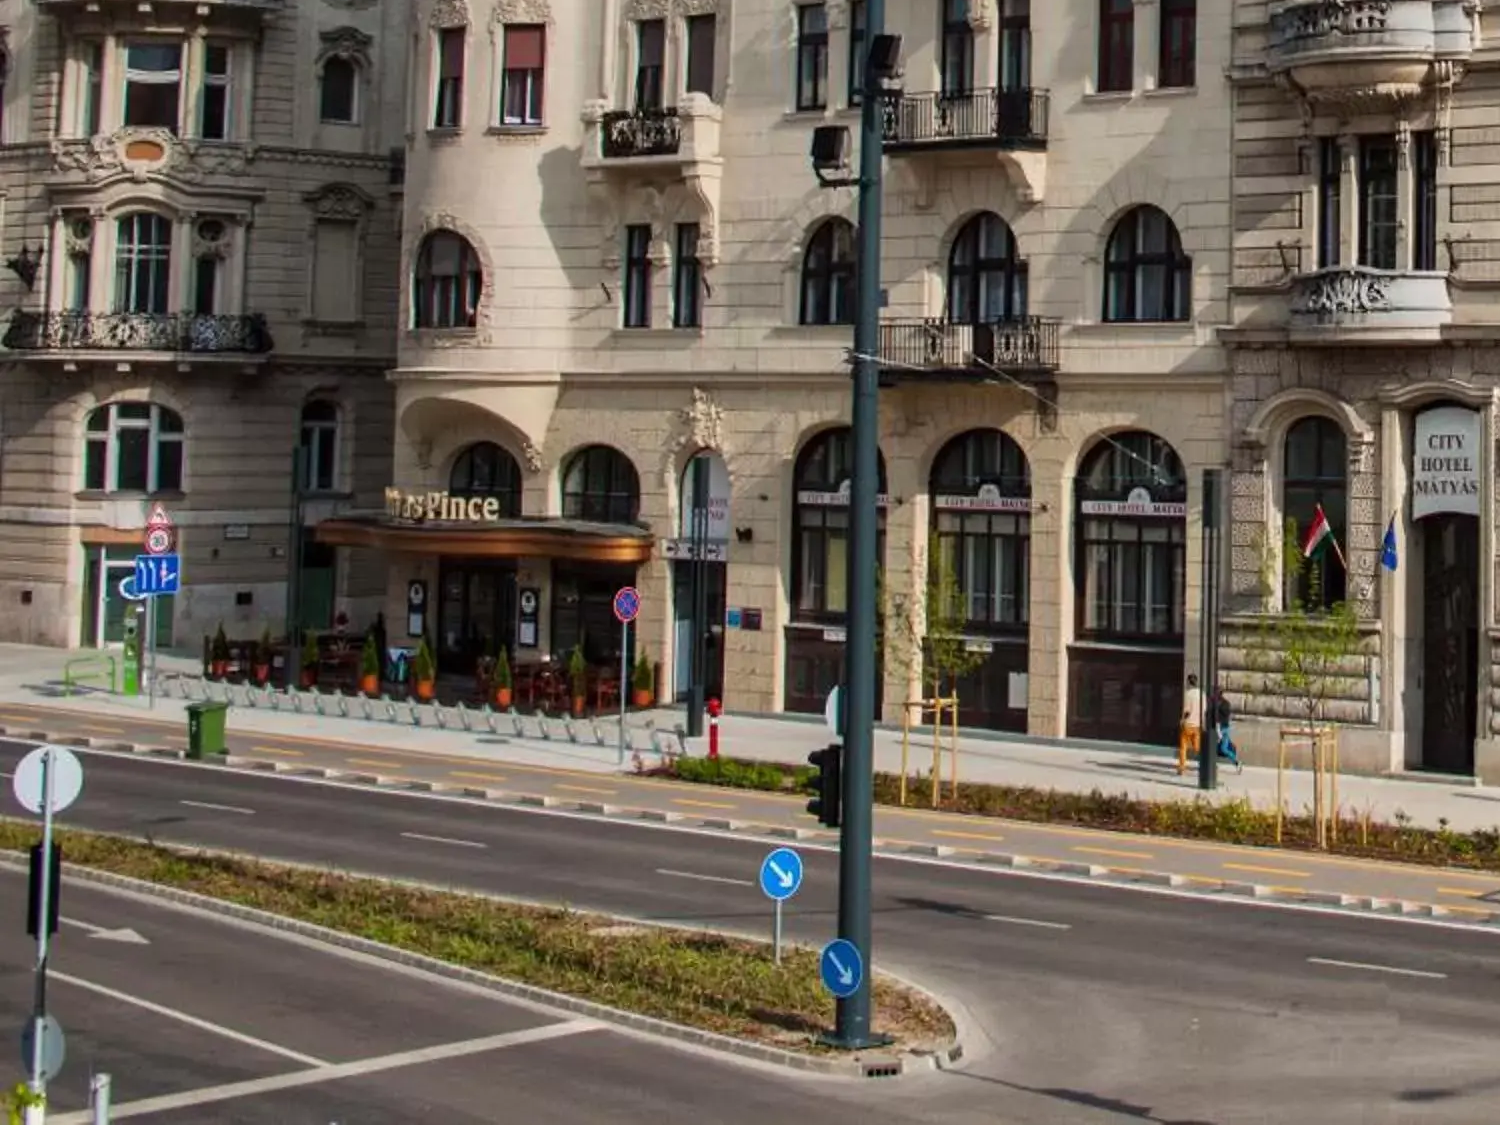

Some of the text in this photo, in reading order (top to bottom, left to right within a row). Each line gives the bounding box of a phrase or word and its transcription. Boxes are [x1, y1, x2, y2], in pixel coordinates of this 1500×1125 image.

[1428, 434, 1465, 449] CITY
[1421, 458, 1472, 472] HOTEL
[1415, 476, 1478, 495] MÁTYÁS
[426, 491, 501, 521] Pince
